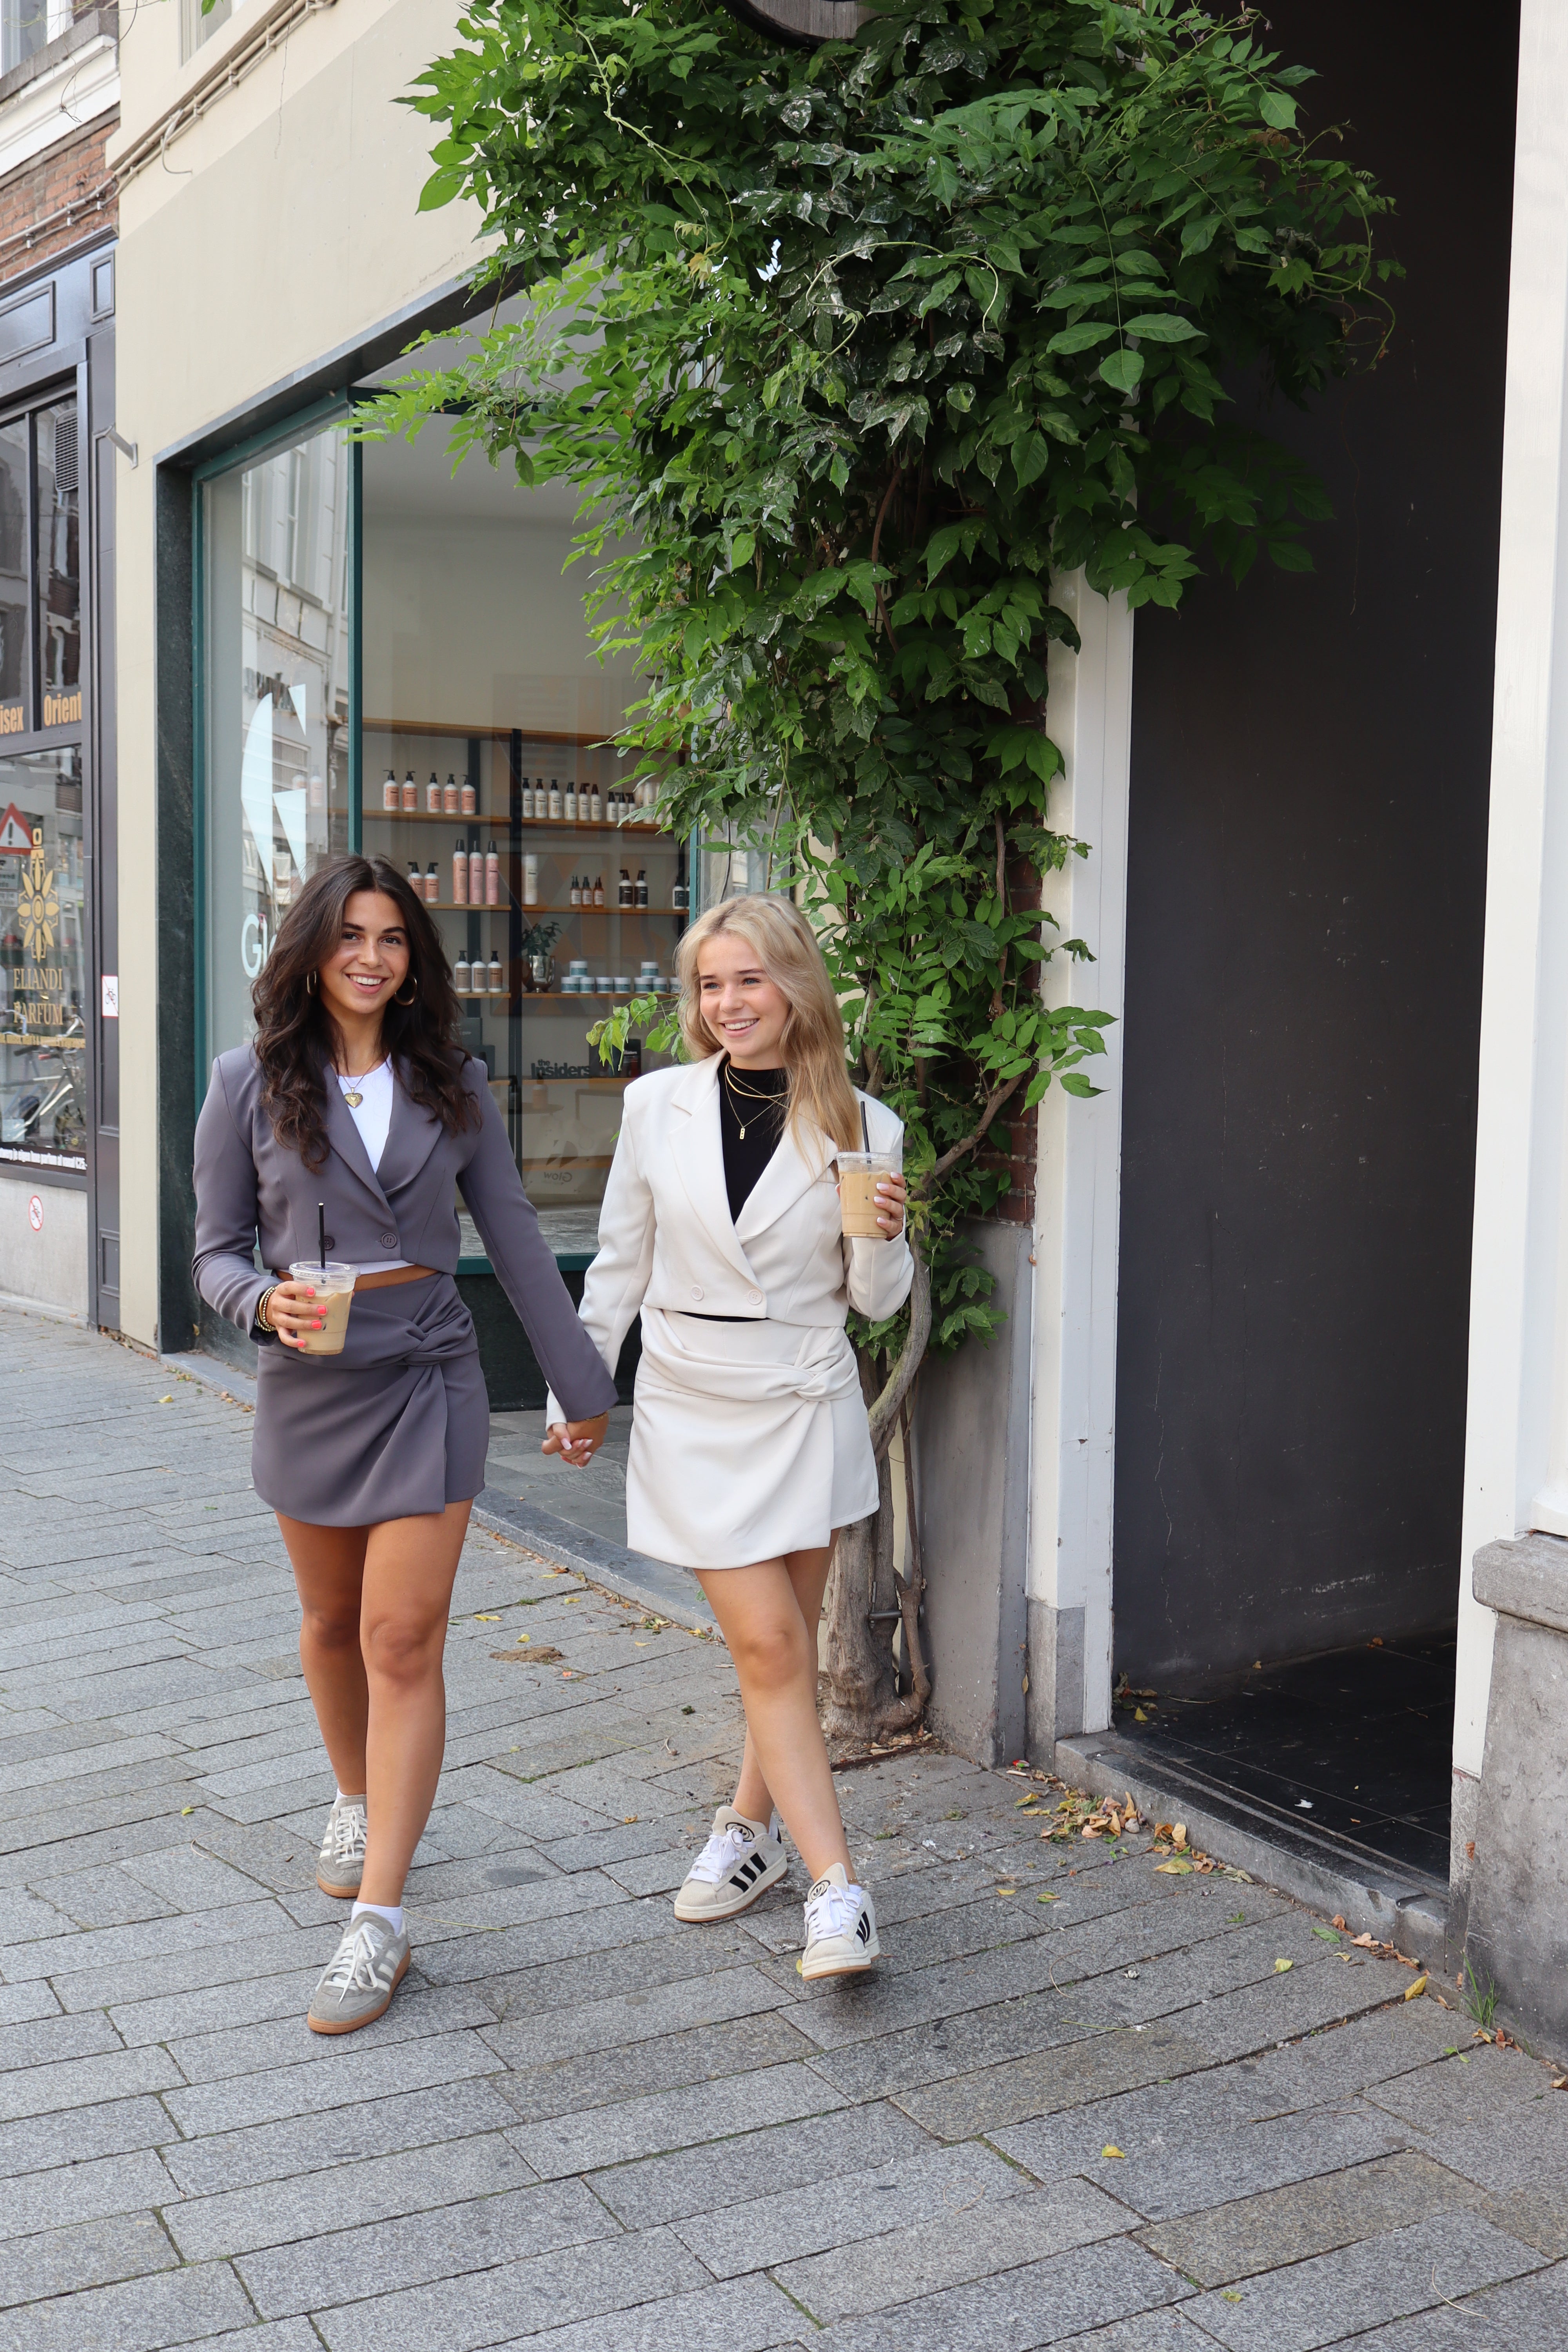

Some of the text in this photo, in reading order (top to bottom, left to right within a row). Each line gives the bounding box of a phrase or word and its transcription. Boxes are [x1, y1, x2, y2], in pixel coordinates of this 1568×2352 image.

[241, 914, 277, 978] Gl
[14, 968, 63, 990] ELIANDI
[531, 1063, 590, 1079] Insiders
